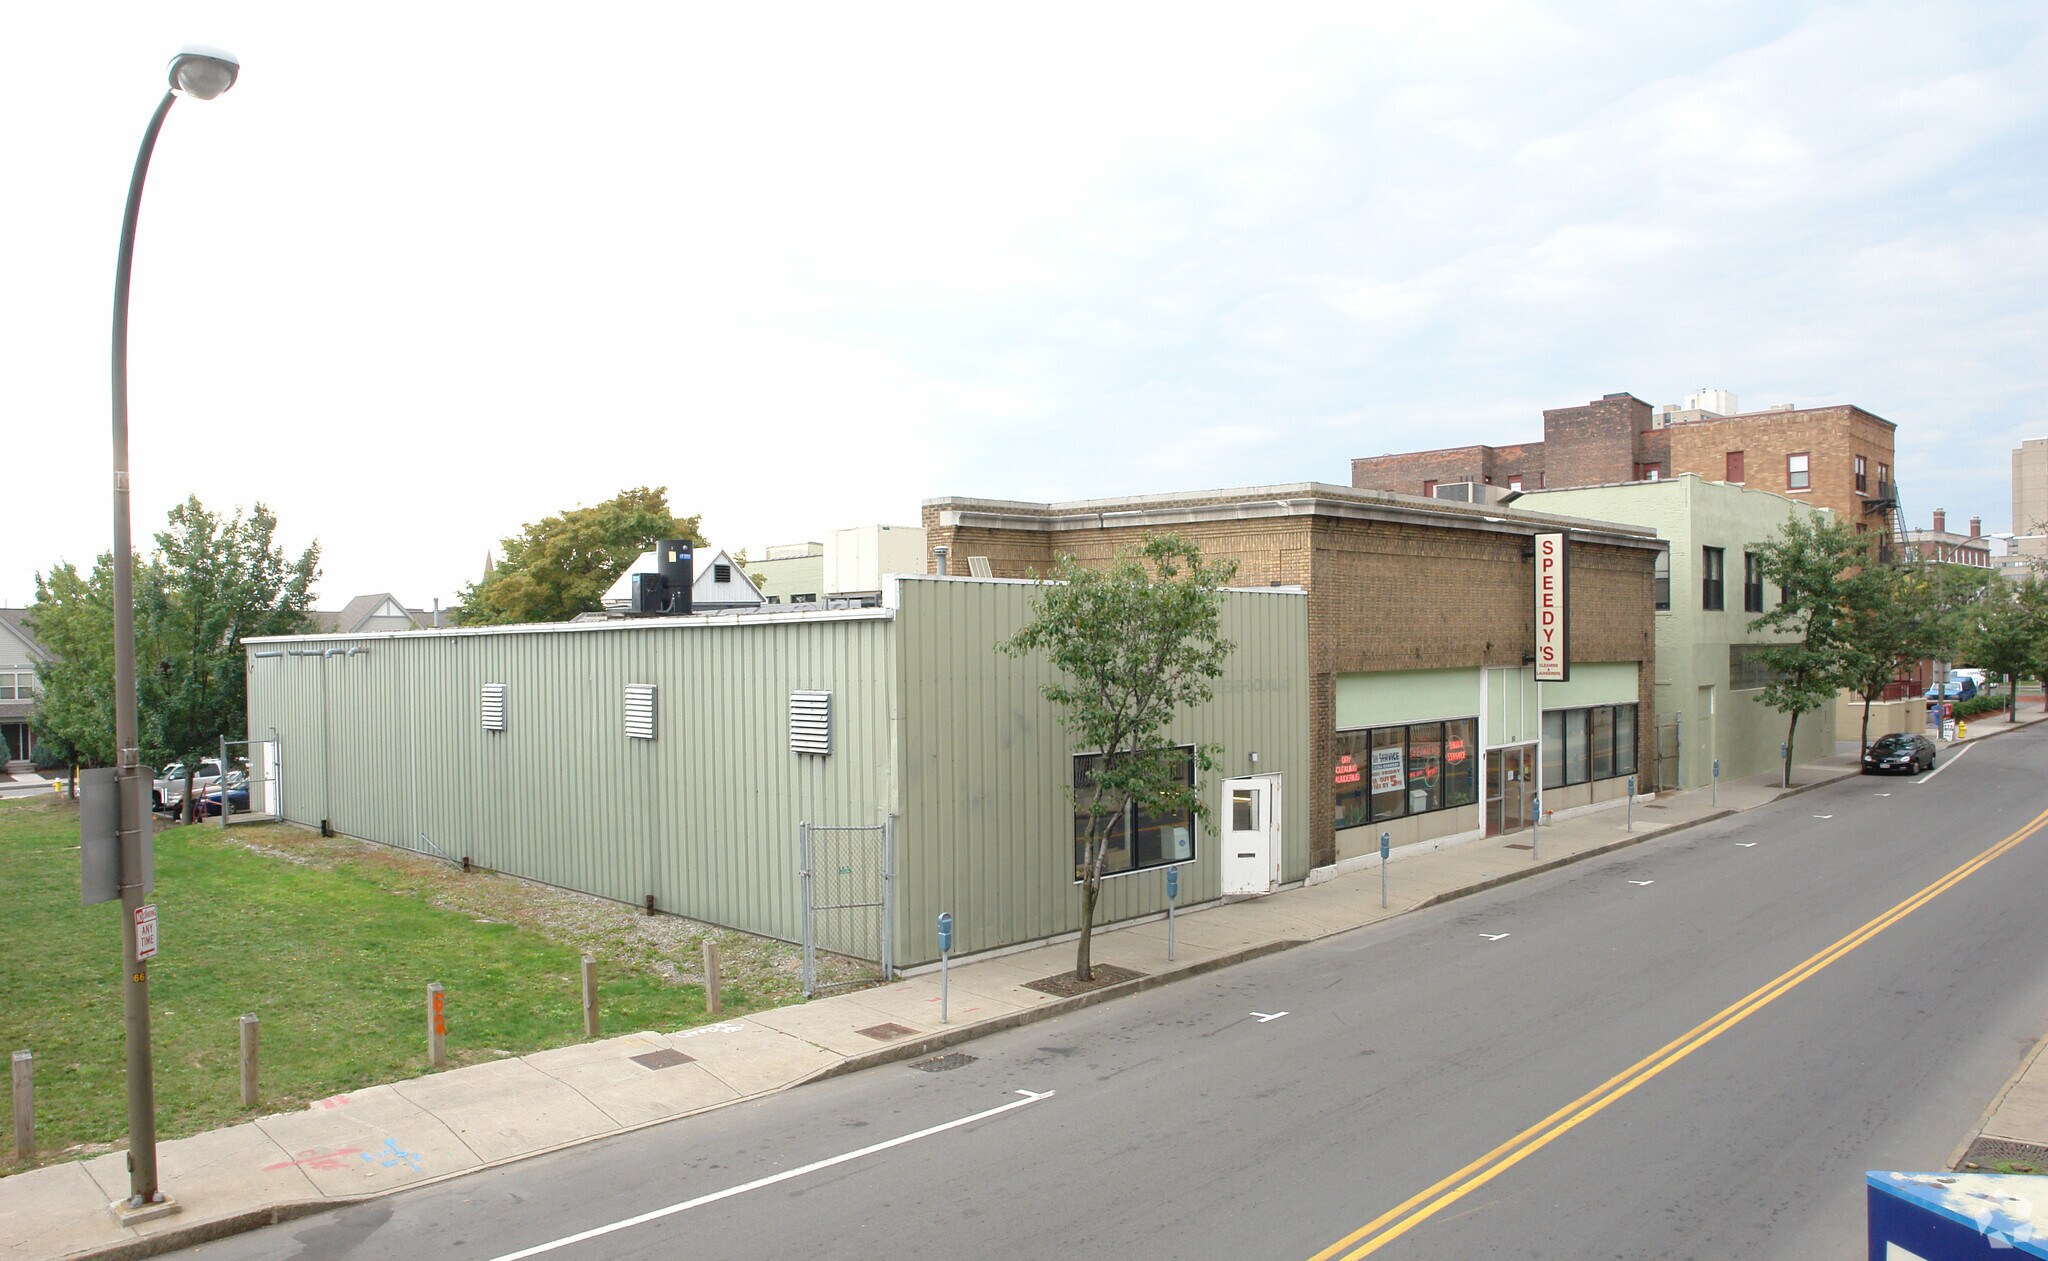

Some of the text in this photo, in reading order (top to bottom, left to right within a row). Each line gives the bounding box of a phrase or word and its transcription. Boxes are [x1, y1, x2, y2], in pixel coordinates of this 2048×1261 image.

[1540, 540, 1554, 661] SPEEDY'S
[1335, 774, 1360, 784] AUNDERING
[142, 923, 153, 936] ANY
[141, 934, 154, 947] TIME
[133, 972, 145, 982] 66
